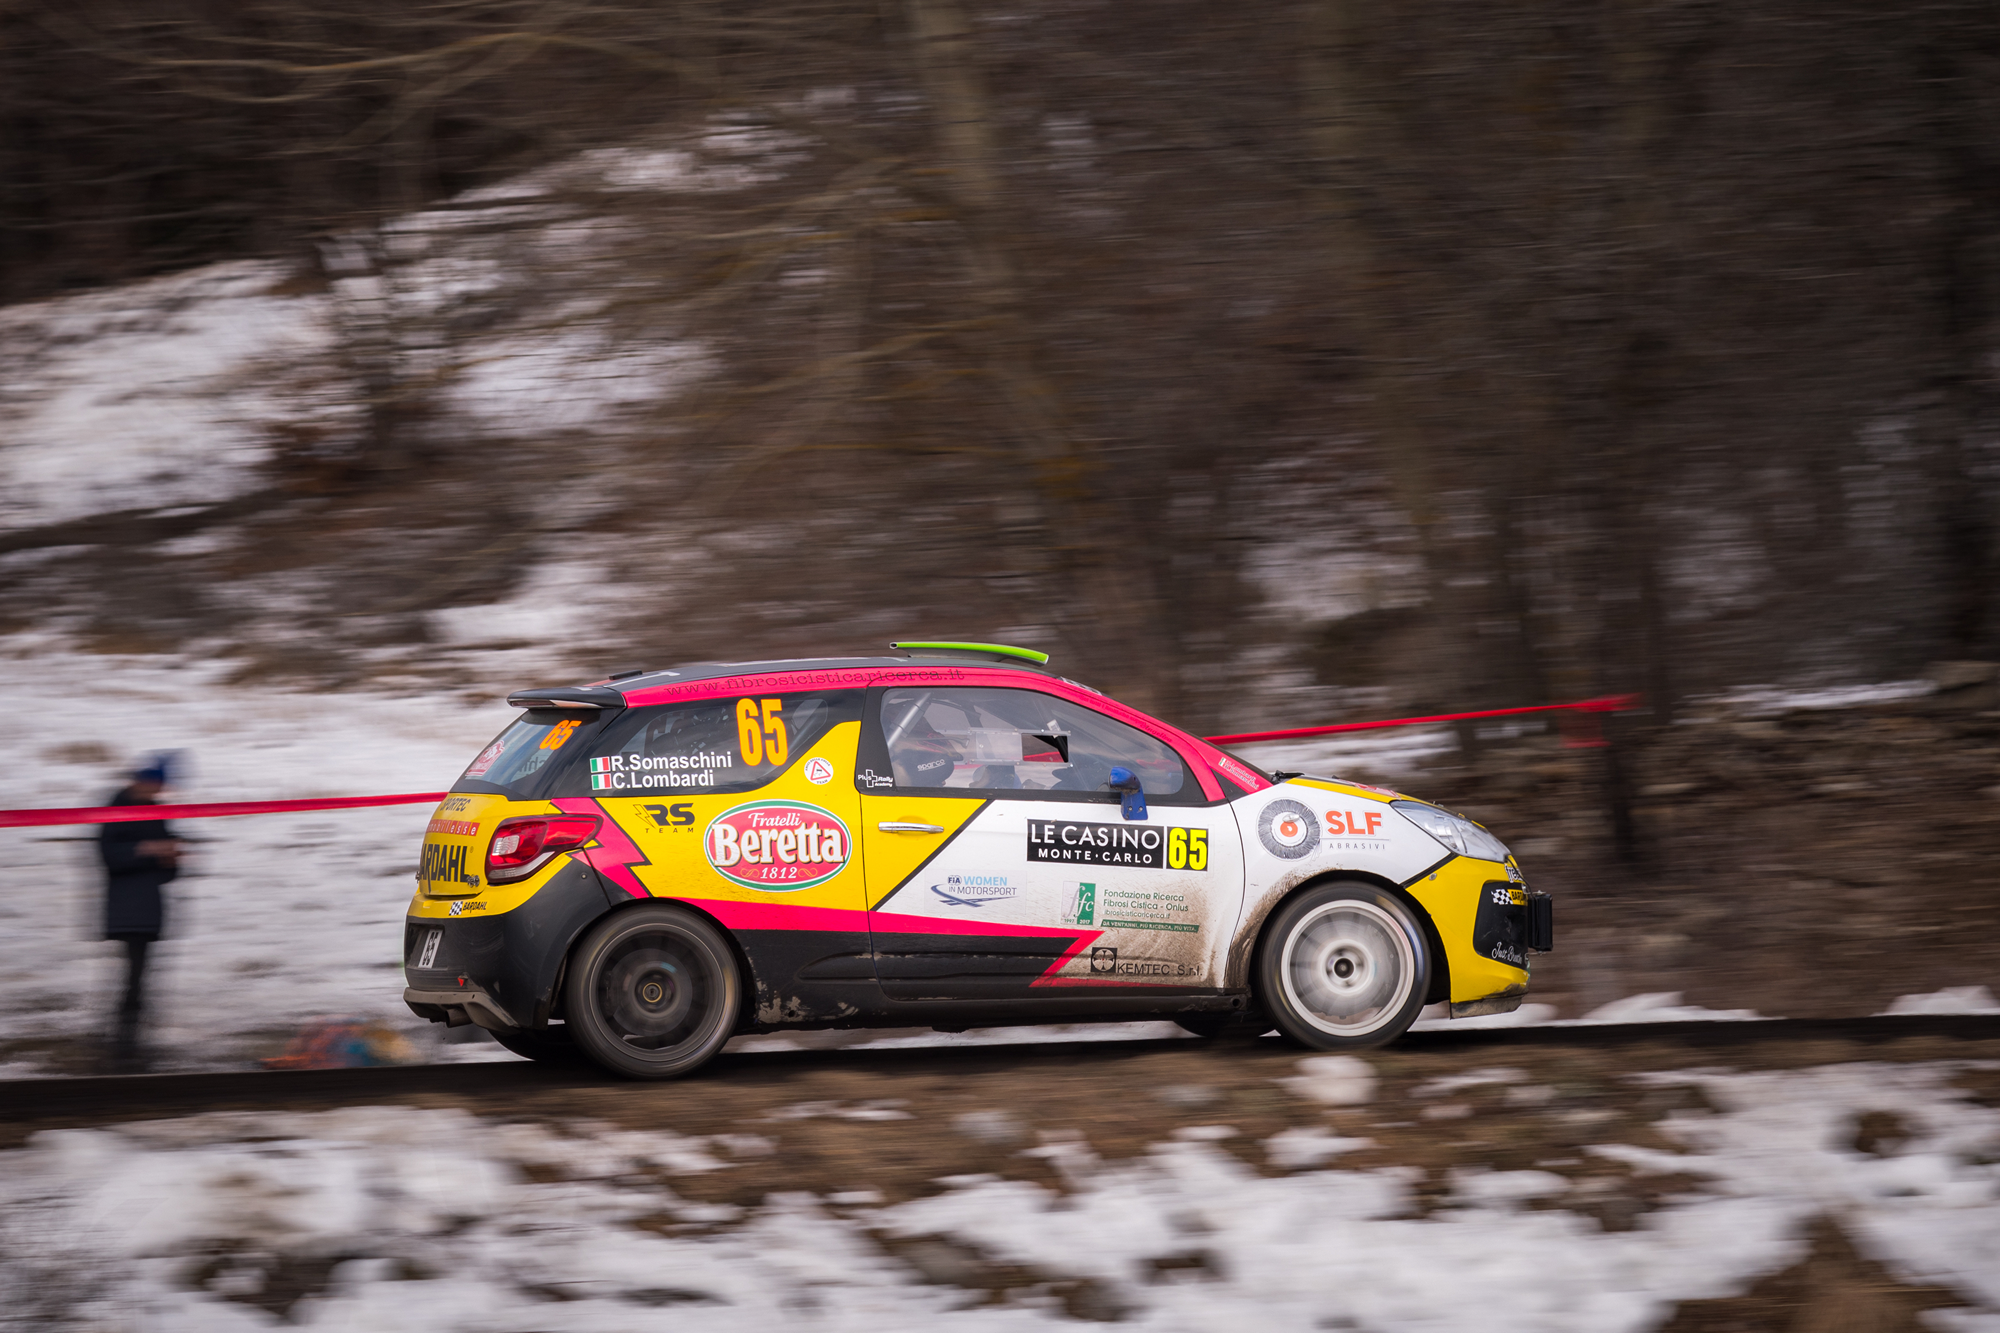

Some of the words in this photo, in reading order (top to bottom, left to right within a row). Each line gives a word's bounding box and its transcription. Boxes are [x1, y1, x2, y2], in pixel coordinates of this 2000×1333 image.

[666, 669, 965, 695] www.fibrosicisticaricerca.it
[539, 719, 582, 751] 65
[736, 697, 788, 767] 65
[611, 751, 732, 772] R.Somaschini
[917, 758, 946, 771] sparco
[612, 769, 714, 789] C.Lombardi
[643, 802, 696, 827] RS
[748, 812, 802, 827] Fratelli
[1325, 810, 1382, 835] SLF
[711, 822, 845, 867] Beretta
[1031, 824, 1055, 844] LE
[1061, 825, 1160, 850] CASINO
[1329, 842, 1386, 850] ABRASIVI
[1168, 827, 1208, 871] 65
[760, 867, 797, 879] 1812
[947, 876, 961, 884] FIA
[963, 876, 1007, 886] WOMEN
[957, 886, 1017, 896] MOTORSPORT
[1103, 889, 1151, 900] Fondazione
[1153, 892, 1184, 902] Ricerca
[1103, 899, 1129, 908] Fibrosi
[1130, 900, 1158, 910] Cistica
[1165, 903, 1189, 912] Onlus
[1117, 963, 1170, 975] KEMTEC
